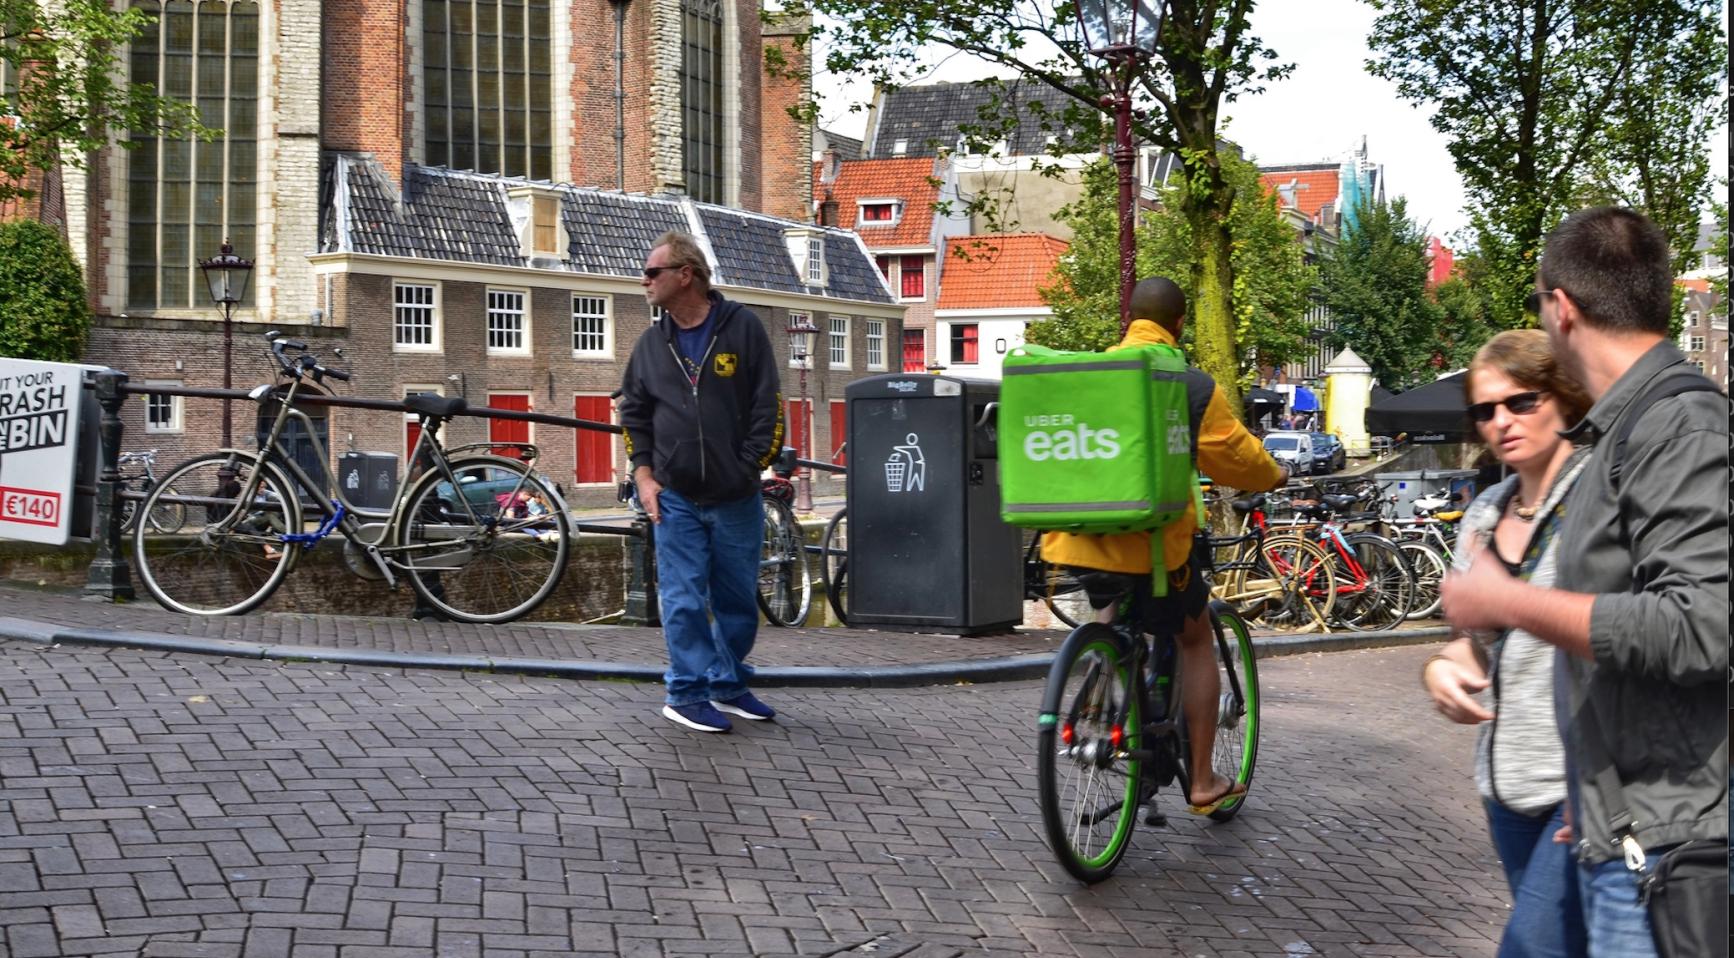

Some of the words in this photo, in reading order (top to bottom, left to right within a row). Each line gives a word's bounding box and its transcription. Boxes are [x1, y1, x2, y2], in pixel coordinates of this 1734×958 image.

[15, 371, 54, 389] YOUR
[0, 385, 66, 416] RASH
[8, 412, 66, 450] BIN
[1023, 414, 1074, 427] UBER
[1023, 422, 1121, 462] eats
[6, 495, 55, 519] €140
